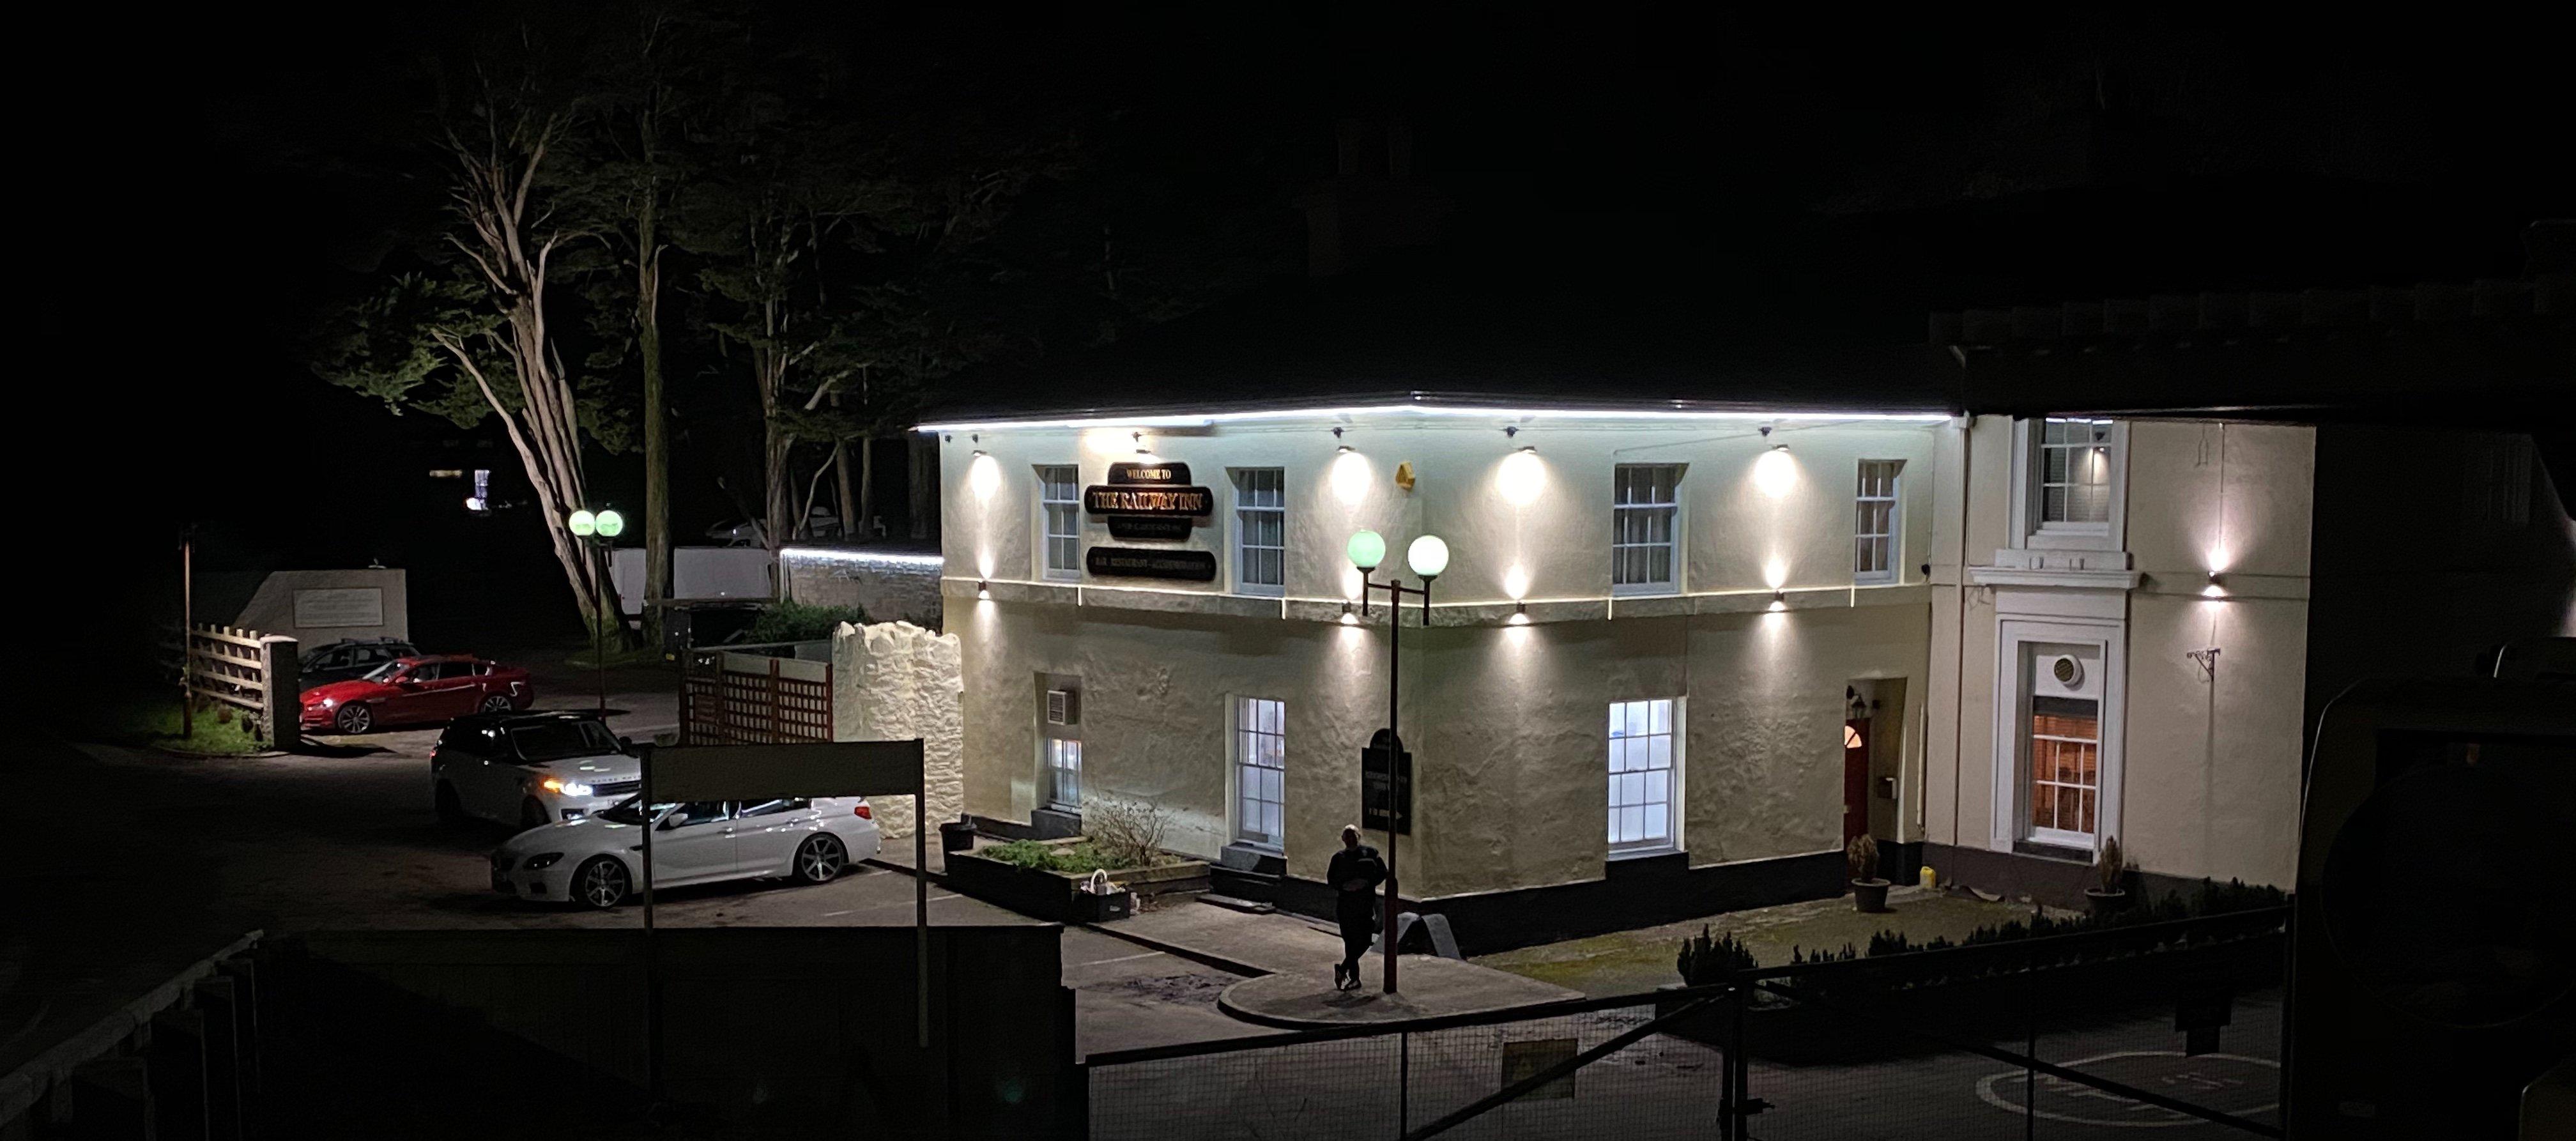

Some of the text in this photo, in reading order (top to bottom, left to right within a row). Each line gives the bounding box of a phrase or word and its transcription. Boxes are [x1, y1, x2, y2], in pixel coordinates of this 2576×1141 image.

[1126, 469, 1172, 479] WELCOME TO
[1092, 492, 1203, 511] THE RAILWAY INN
